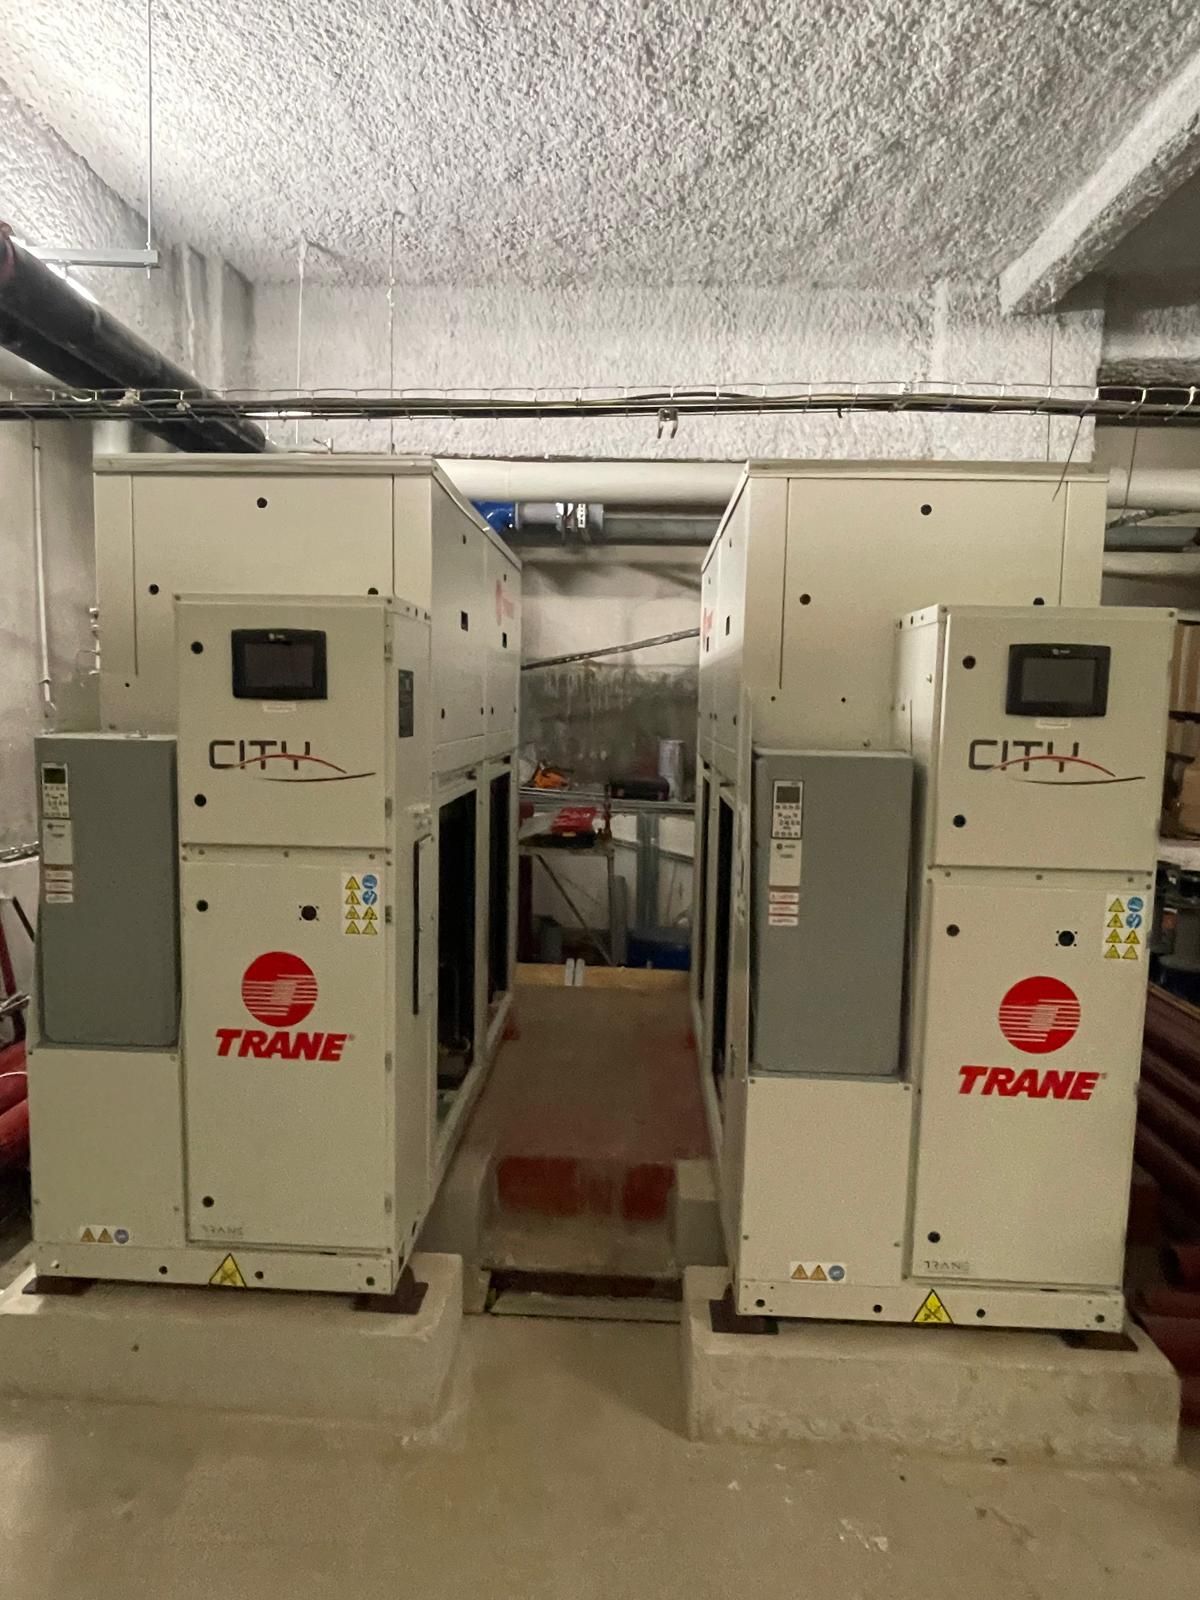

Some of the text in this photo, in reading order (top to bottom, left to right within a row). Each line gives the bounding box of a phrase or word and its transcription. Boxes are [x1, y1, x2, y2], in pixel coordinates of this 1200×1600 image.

[209, 739, 310, 770] CITY
[969, 739, 1079, 773] CITY
[216, 1028, 348, 1061] TRANE
[959, 1065, 1100, 1101] TRANE
